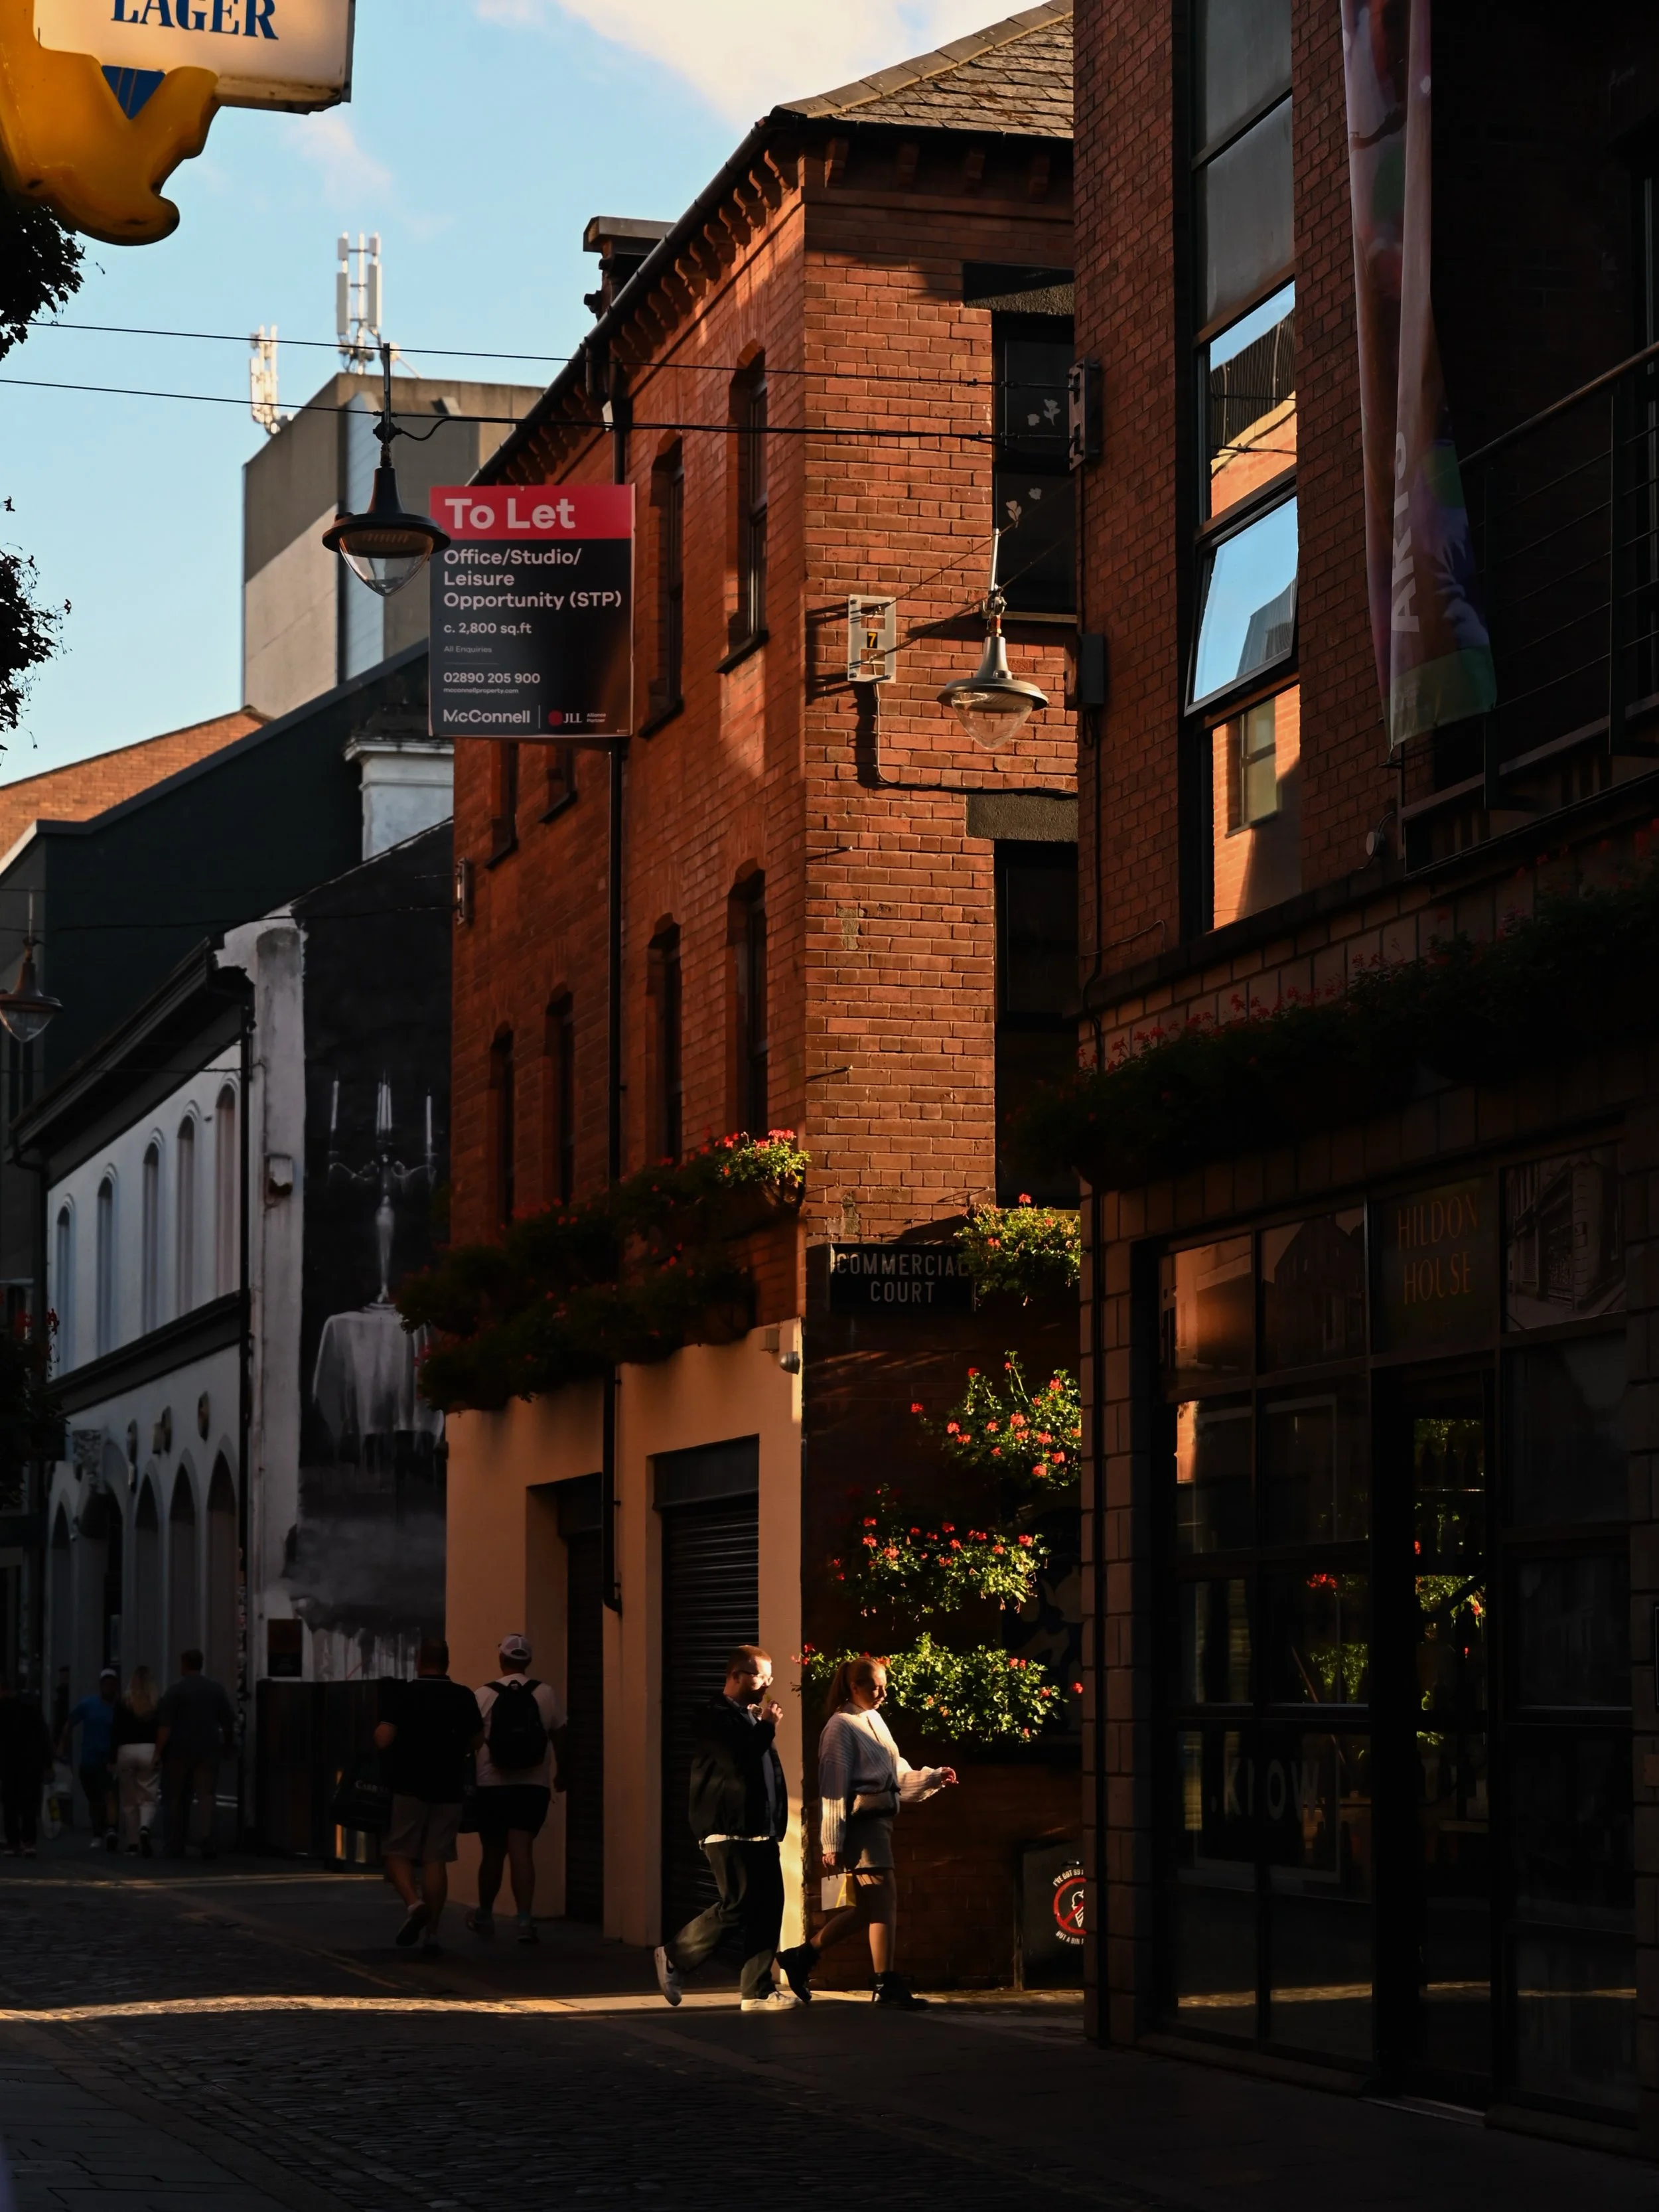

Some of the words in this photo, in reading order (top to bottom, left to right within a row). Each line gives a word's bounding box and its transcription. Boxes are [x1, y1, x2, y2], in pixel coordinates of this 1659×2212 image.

[445, 498, 495, 529] To
[507, 498, 576, 529] Let
[444, 548, 582, 565] Office/Studio/
[444, 571, 515, 586] Leisure
[444, 592, 565, 610] Opportunity
[569, 591, 622, 608] (STP)
[444, 624, 455, 634] c.
[459, 623, 496, 634] 2,800
[500, 623, 532, 635] sq.ft
[868, 632, 877, 648] 7
[443, 672, 484, 683] 02890
[488, 673, 511, 683] 205
[514, 673, 541, 684] 900
[443, 709, 530, 723] McConnell
[563, 713, 583, 723] JLL
[1397, 1193, 1479, 1251] HILDON
[836, 1252, 970, 1276] COMMERCIAL
[1404, 1250, 1472, 1305] HOUSE
[870, 1281, 936, 1303] COURT
[1062, 1870, 1072, 1880] GOT
